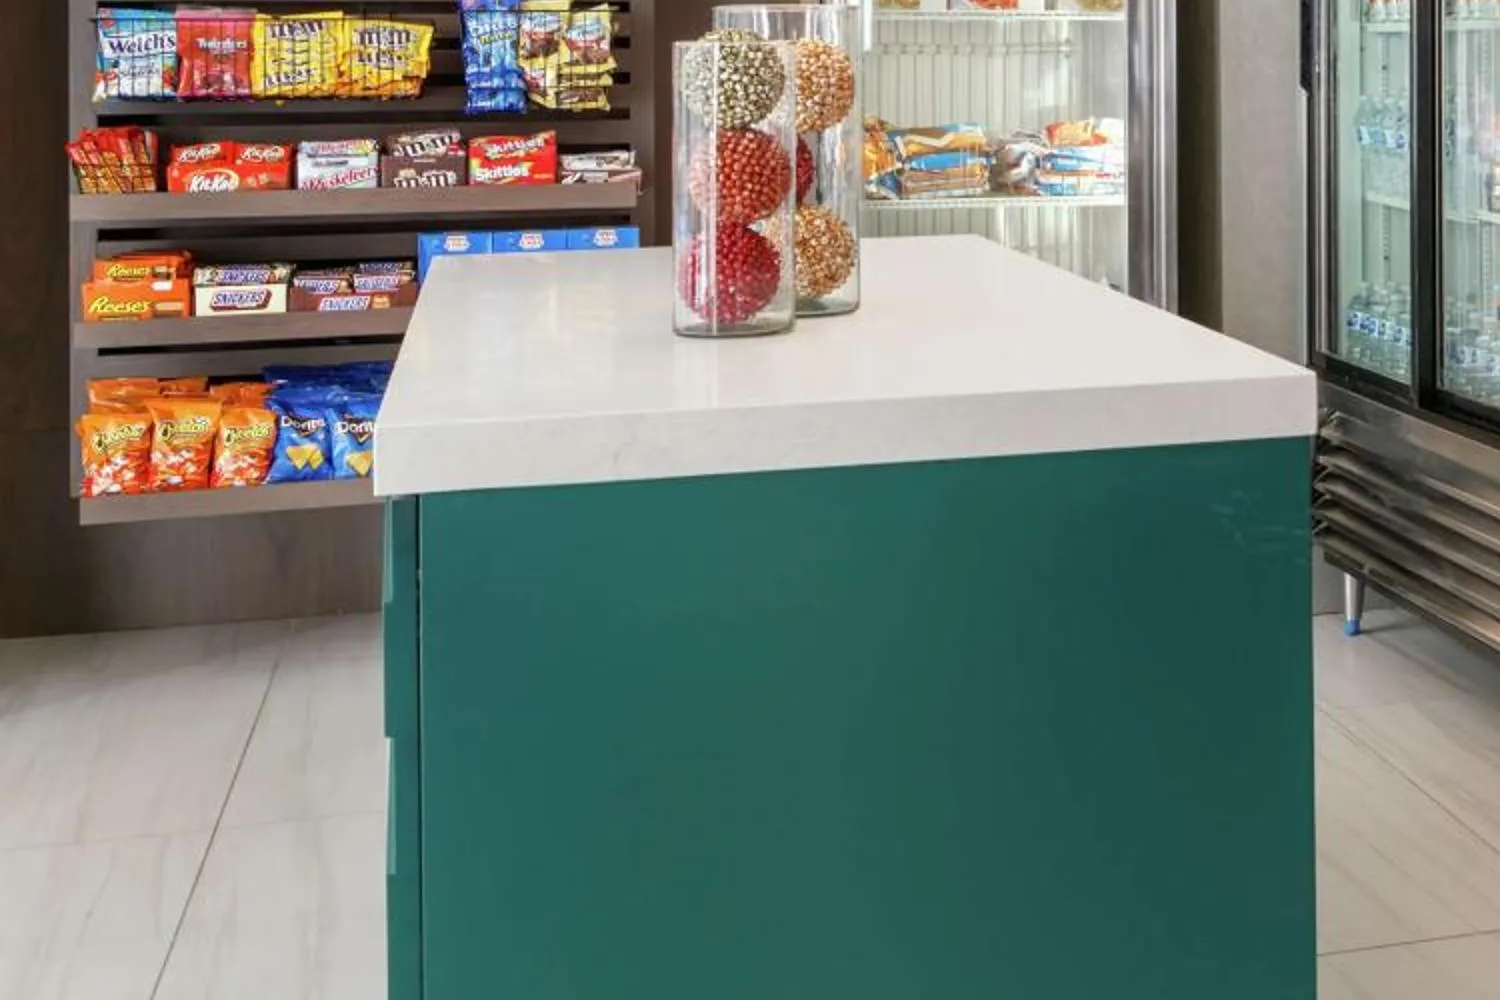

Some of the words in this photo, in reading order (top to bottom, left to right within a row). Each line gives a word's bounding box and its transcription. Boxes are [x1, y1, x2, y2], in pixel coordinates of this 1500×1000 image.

[109, 33, 176, 53] Welch's
[475, 165, 530, 182] Skittles
[215, 290, 265, 306] SNICKERS
[281, 415, 331, 431] Doritos
